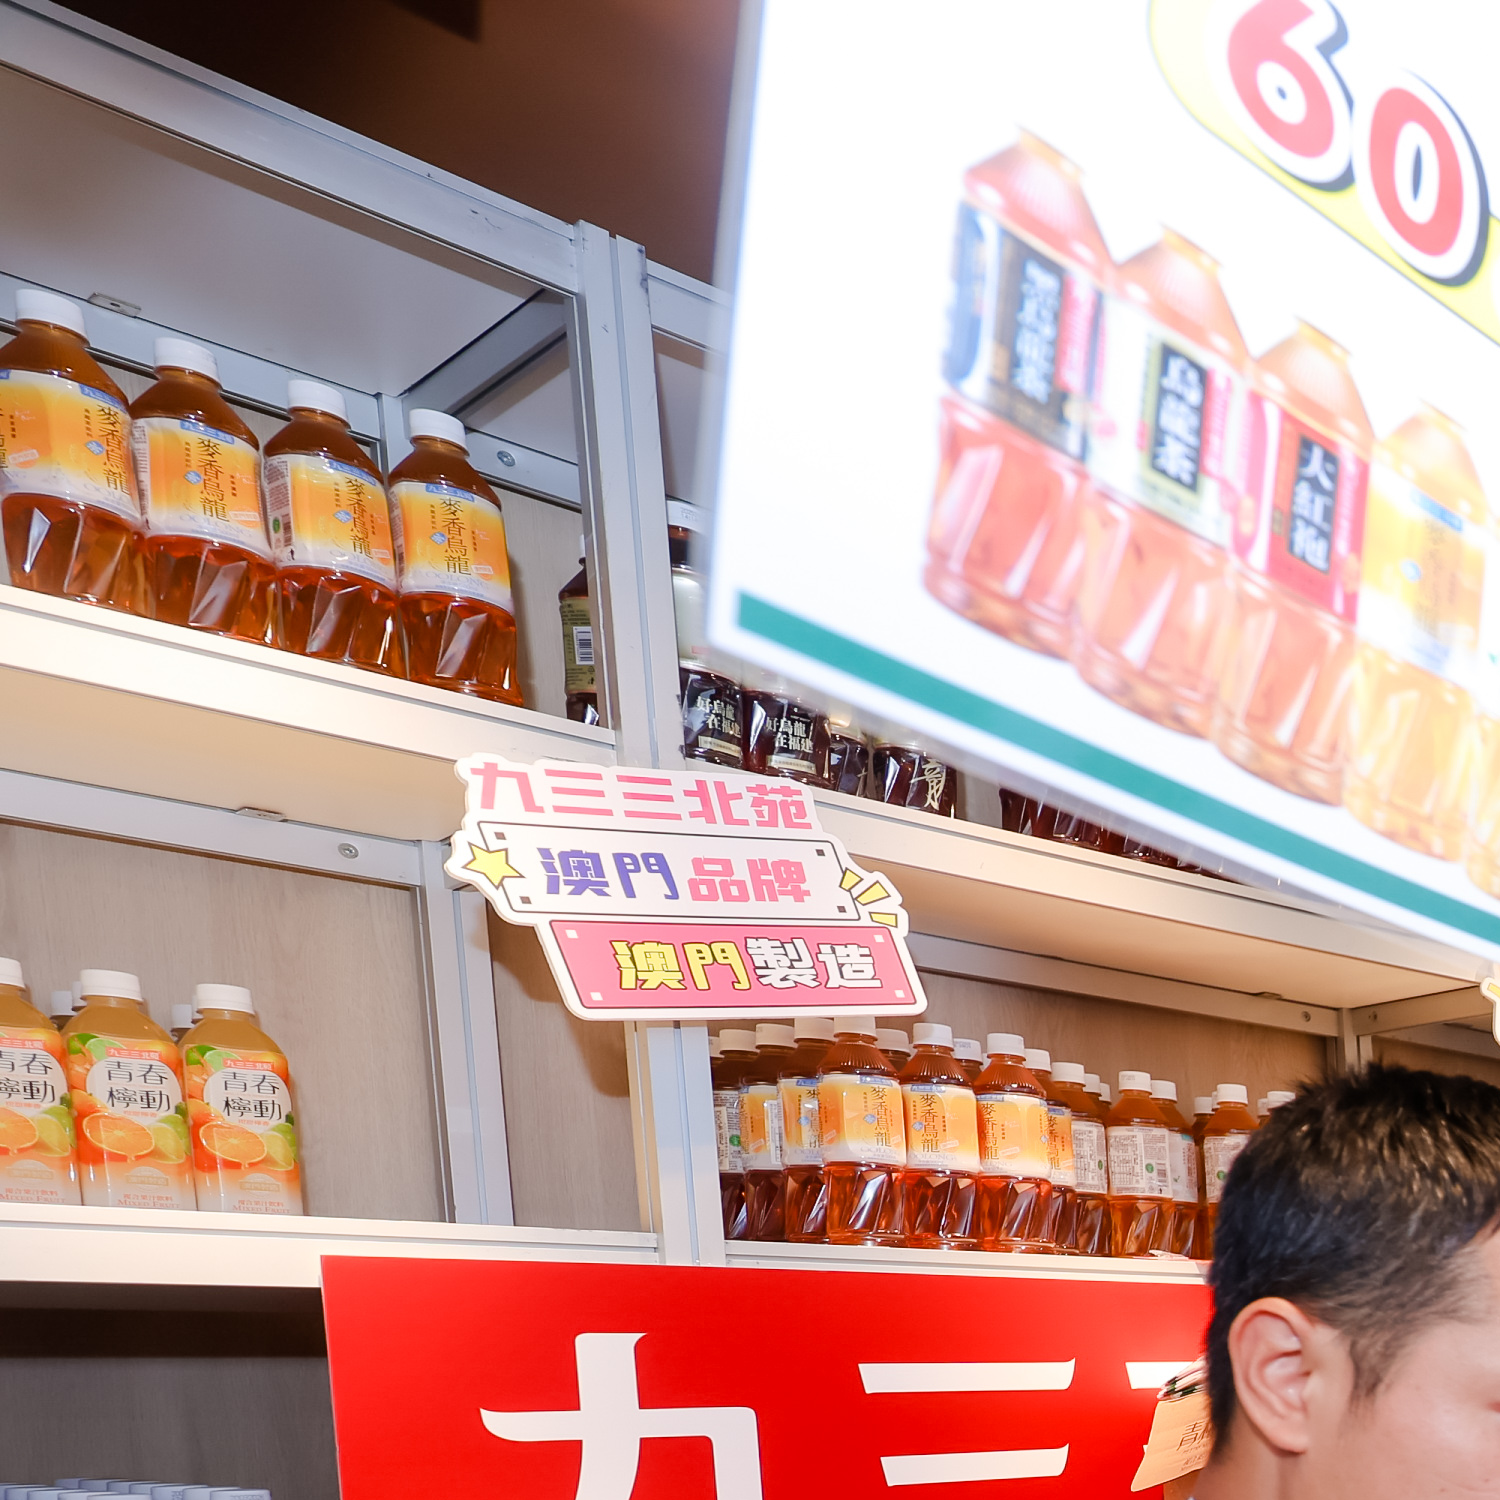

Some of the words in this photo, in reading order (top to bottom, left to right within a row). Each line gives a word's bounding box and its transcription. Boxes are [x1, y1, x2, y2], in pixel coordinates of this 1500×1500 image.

[1228, 0, 1464, 257] 60
[440, 497, 472, 576] 麥香烏龍
[766, 716, 806, 739] 好烏龍
[470, 759, 813, 830] 九三三北苑
[537, 847, 811, 904] 澳門品牌
[609, 935, 884, 994] 澳門製造
[105, 1060, 169, 1086] 青春
[107, 1086, 171, 1113] 檸動
[222, 1070, 281, 1096] 青春
[223, 1095, 284, 1122] 檸動
[870, 1085, 893, 1149] 麥香烏龍
[919, 1092, 941, 1154] 麥香烏龍
